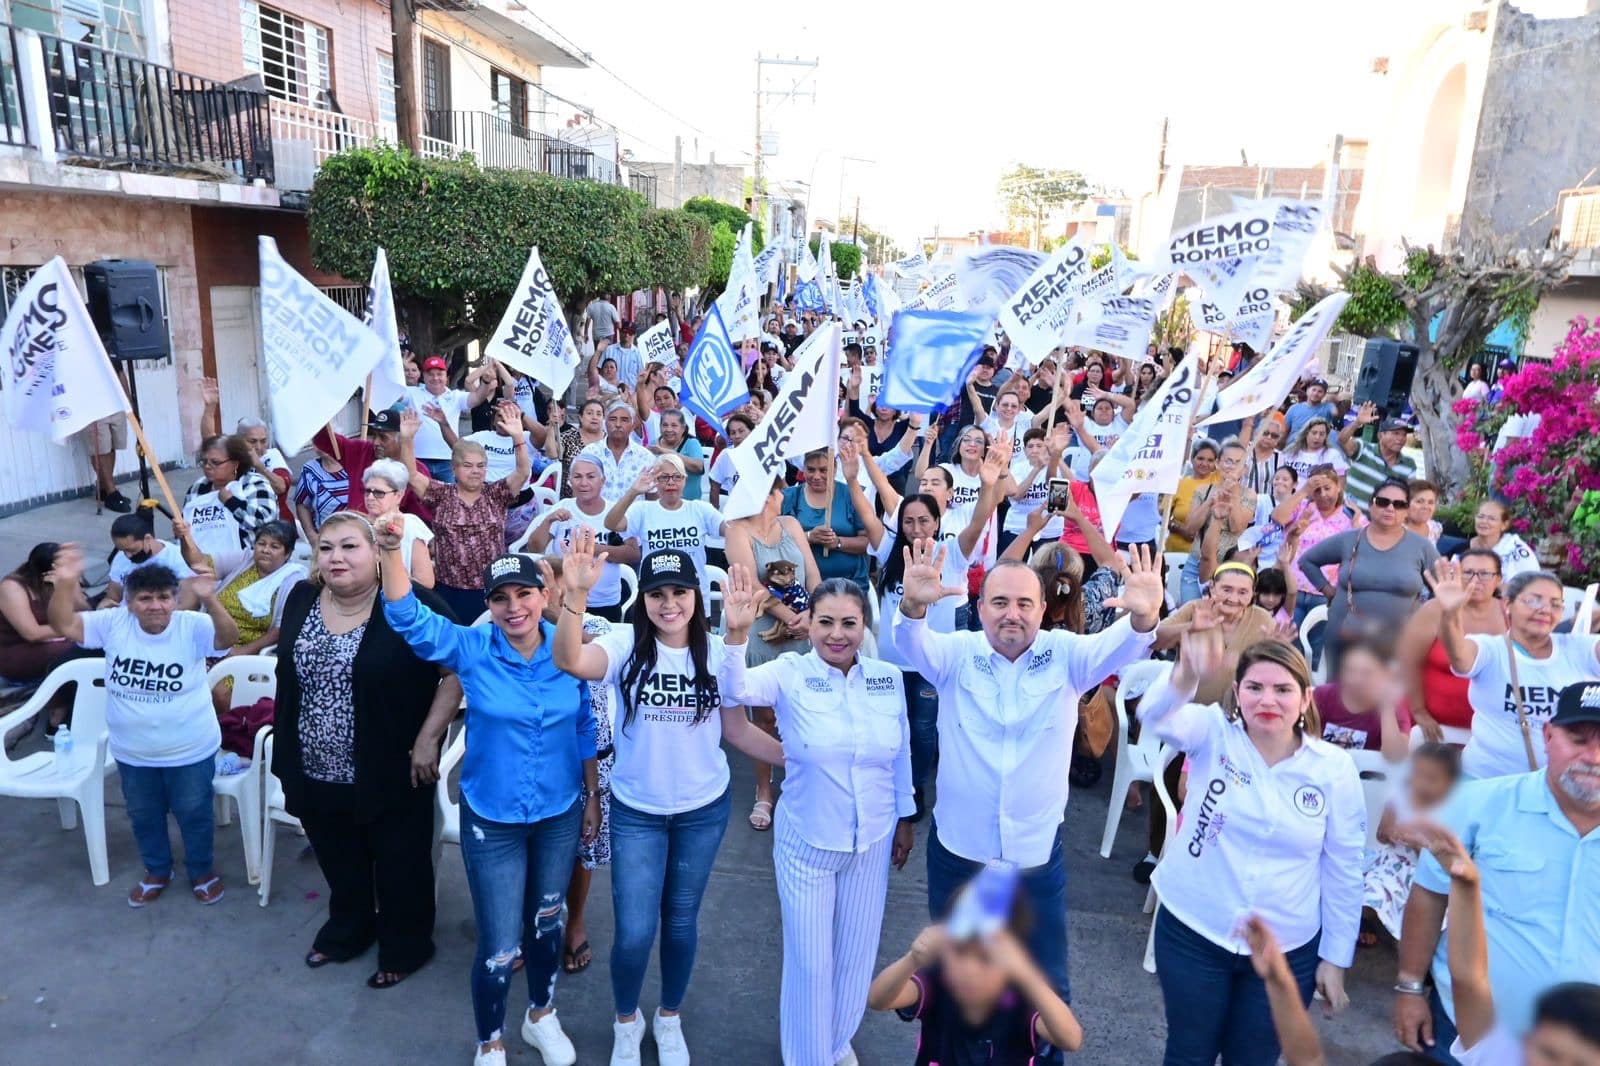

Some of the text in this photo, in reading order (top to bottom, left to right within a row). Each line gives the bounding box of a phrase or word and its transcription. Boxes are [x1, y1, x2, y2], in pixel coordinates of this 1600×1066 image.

[1170, 218, 1270, 250] MEMO
[1171, 238, 1270, 264] ROMERO
[1012, 246, 1084, 317] MEMO
[1082, 275, 1114, 297] ROMER
[1153, 272, 1174, 292] MEM
[503, 267, 545, 351] MEMO
[1203, 301, 1271, 324] ROERO
[645, 327, 672, 353] MEM
[753, 353, 825, 462] MEM
[1286, 461, 1312, 471] MEM
[952, 486, 981, 497] MEM
[193, 505, 225, 518] MEM
[648, 526, 698, 541] MEMO
[649, 538, 700, 550] ROMERO
[652, 554, 681, 564] MEMO
[112, 654, 184, 680] MEMO
[110, 670, 183, 692] ROMERO
[866, 676, 894, 686] MEMO
[866, 684, 896, 692] ROMERO
[1504, 683, 1562, 703] MEM
[1504, 703, 1552, 717] ROM
[1188, 778, 1226, 859] CHAYITO
